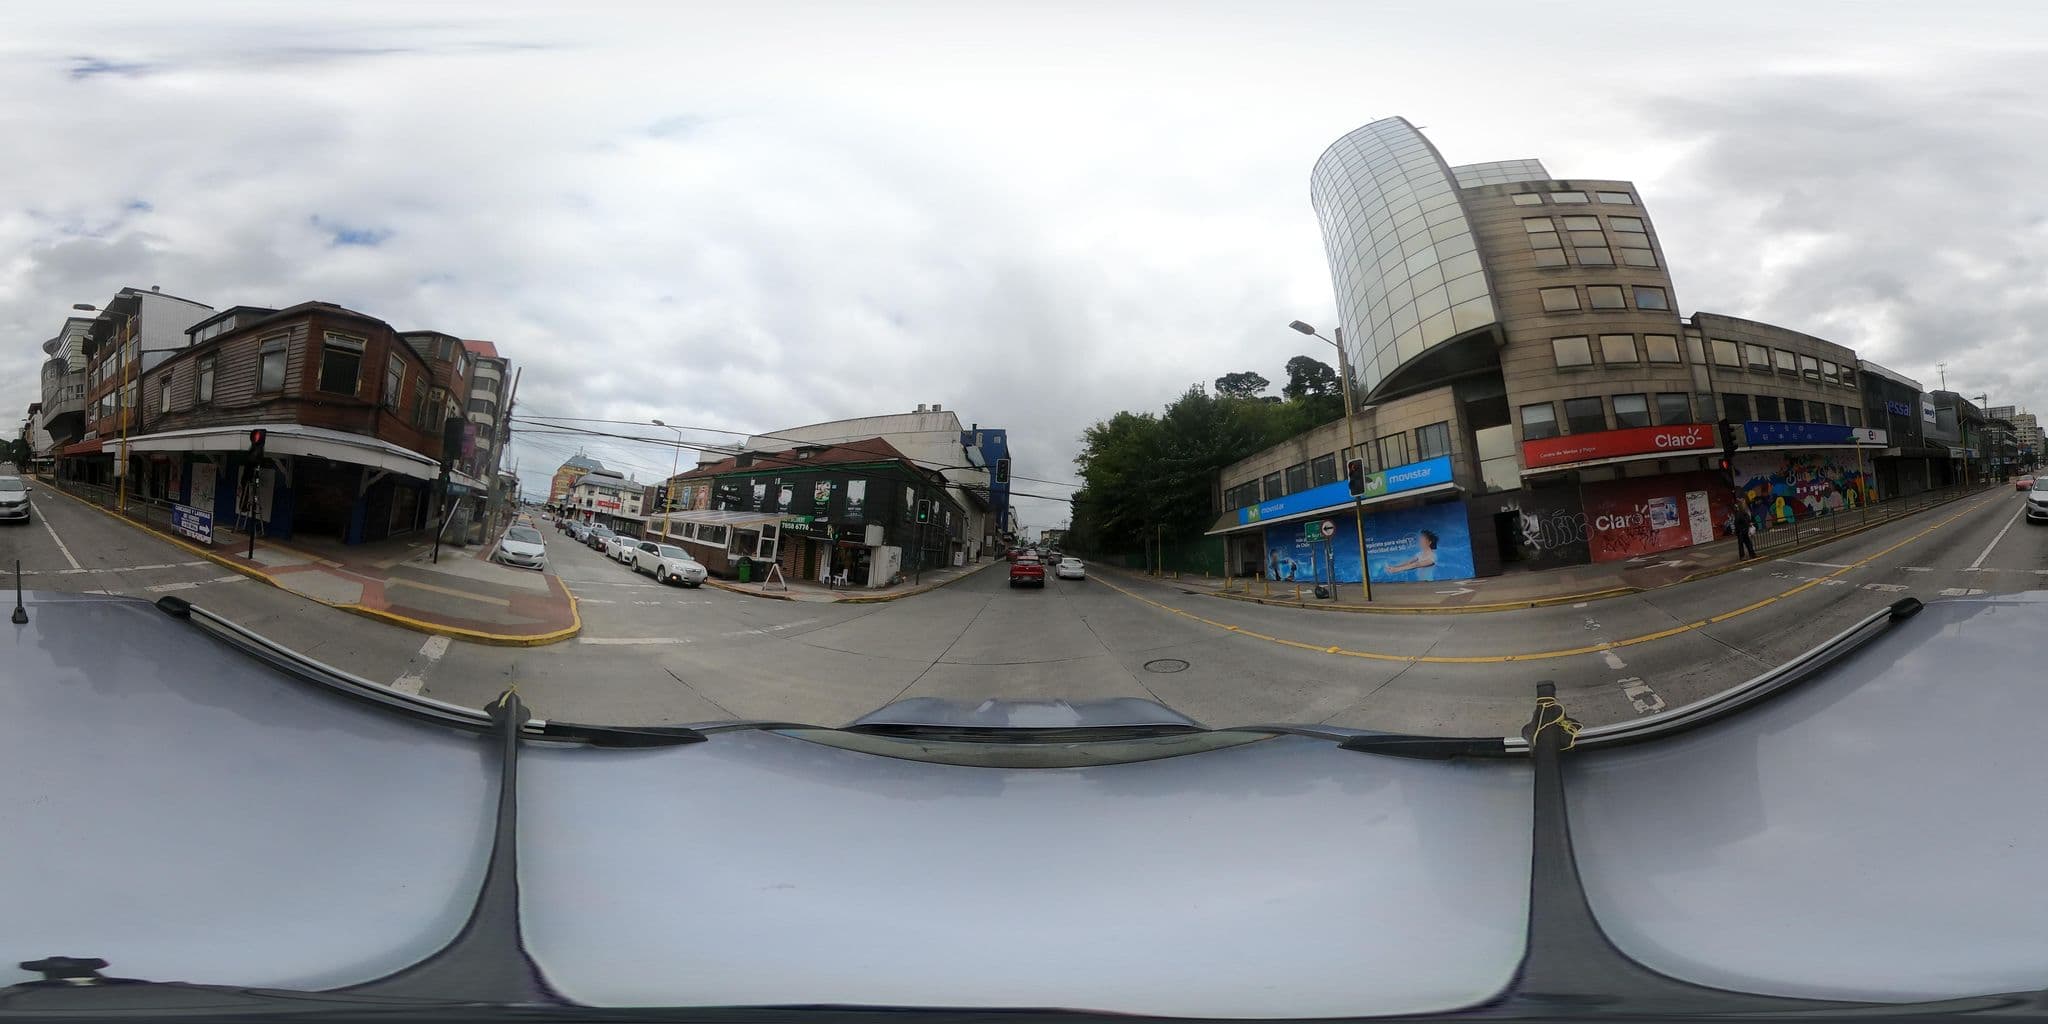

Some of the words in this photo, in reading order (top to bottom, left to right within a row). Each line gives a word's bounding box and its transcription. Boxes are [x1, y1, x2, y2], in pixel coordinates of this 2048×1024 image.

[1888, 400, 1910, 417] essal
[1655, 433, 1696, 448] Claro
[1389, 468, 1431, 484] movistar
[1261, 503, 1285, 514] movistar
[1595, 513, 1643, 531] Claro
